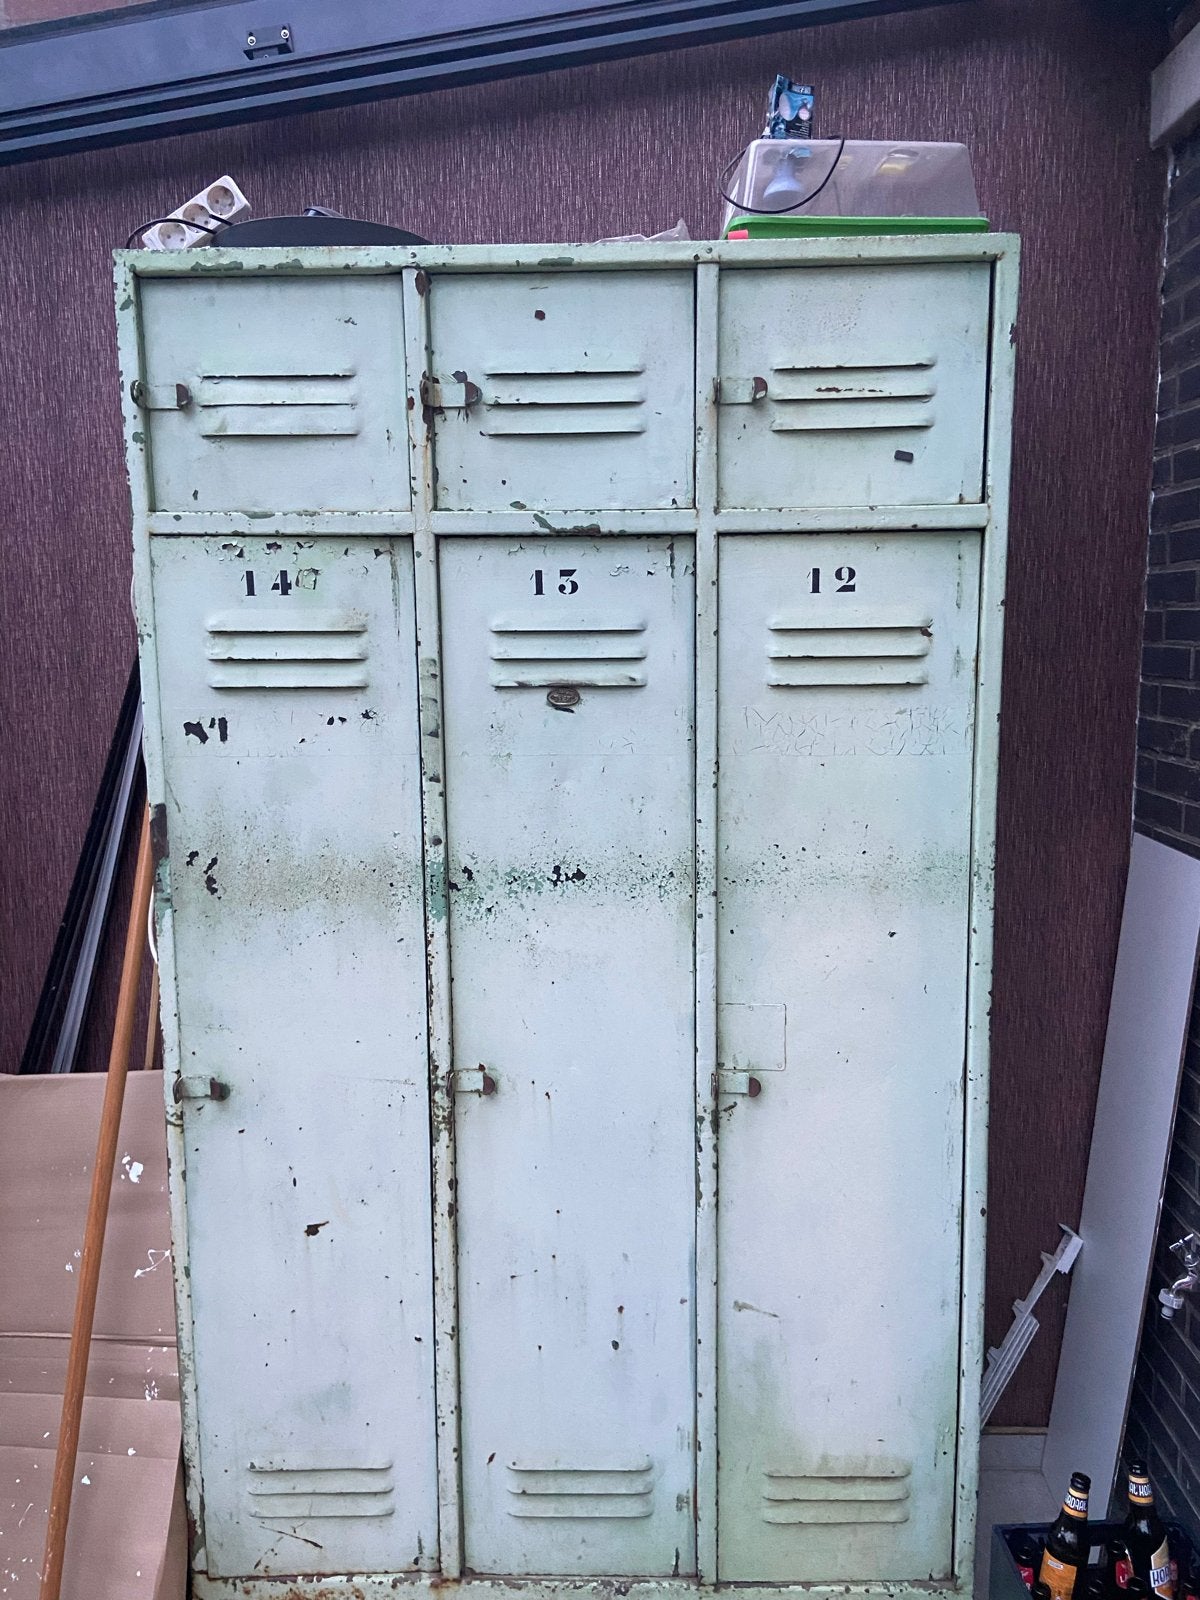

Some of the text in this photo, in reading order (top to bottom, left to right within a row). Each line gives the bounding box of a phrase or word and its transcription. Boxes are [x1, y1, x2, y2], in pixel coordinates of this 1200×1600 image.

[240, 569, 292, 597] 14
[530, 568, 579, 596] 13
[806, 566, 857, 594] 12
